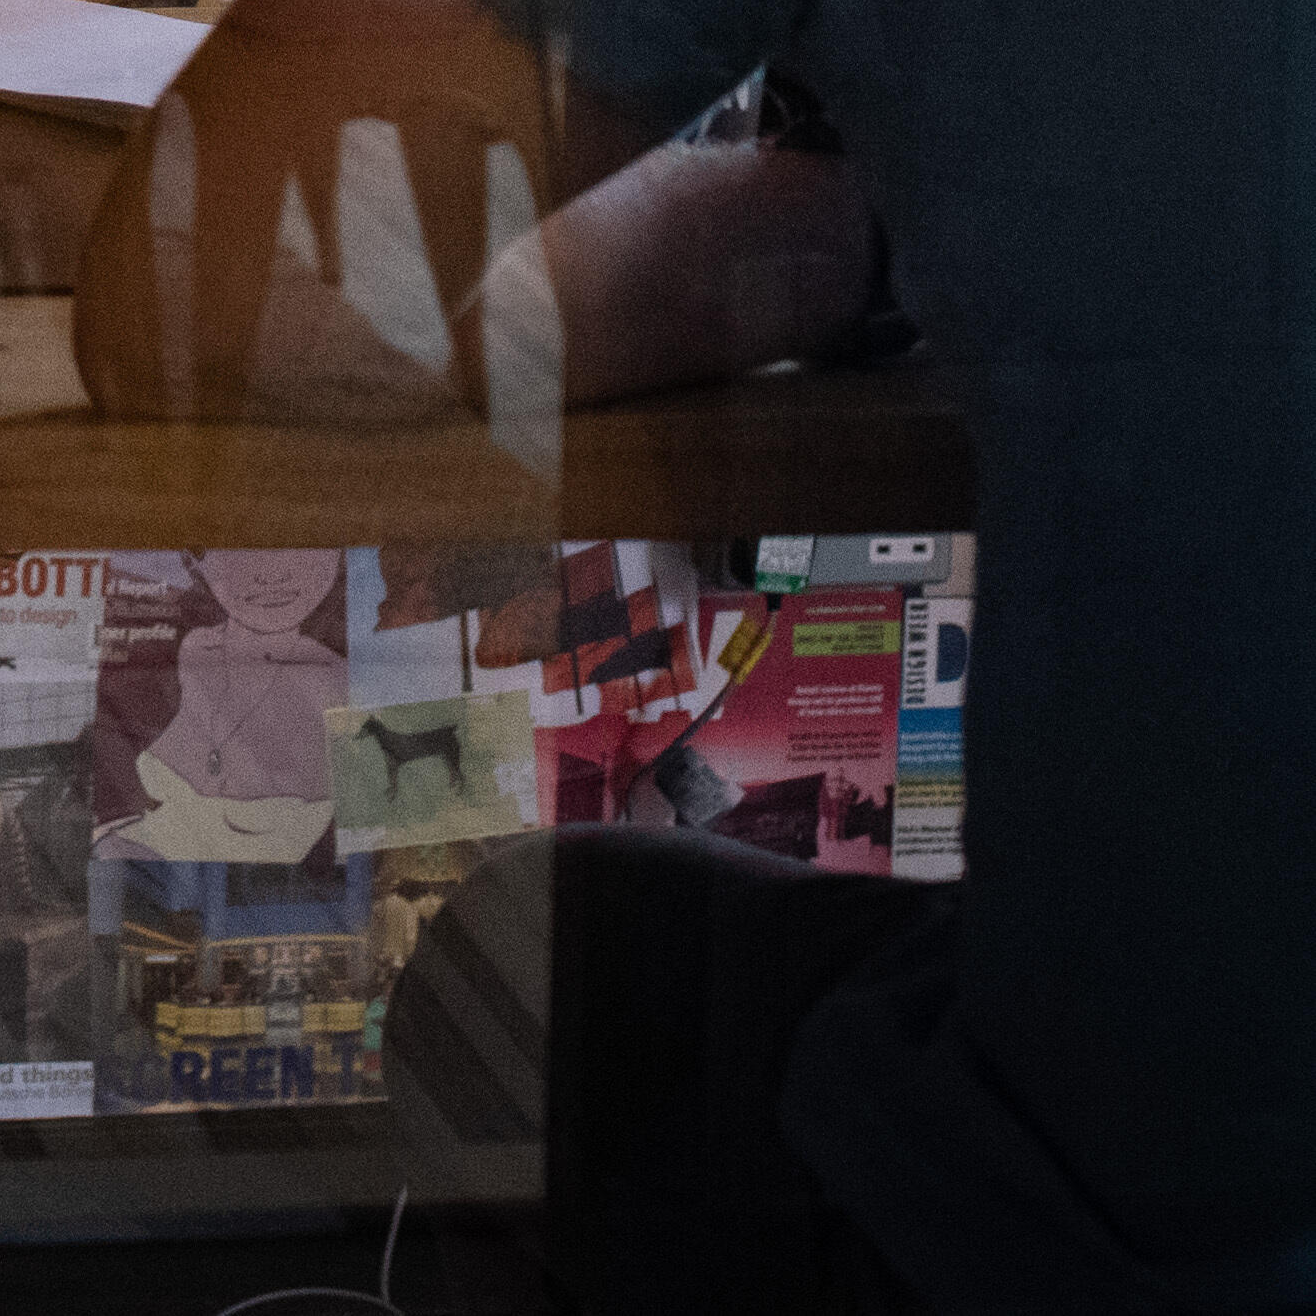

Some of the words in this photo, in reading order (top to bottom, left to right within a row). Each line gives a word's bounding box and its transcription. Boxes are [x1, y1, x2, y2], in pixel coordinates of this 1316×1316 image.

[0, 607, 14, 623] to
[20, 606, 78, 628] design
[23, 1062, 93, 1086] things
